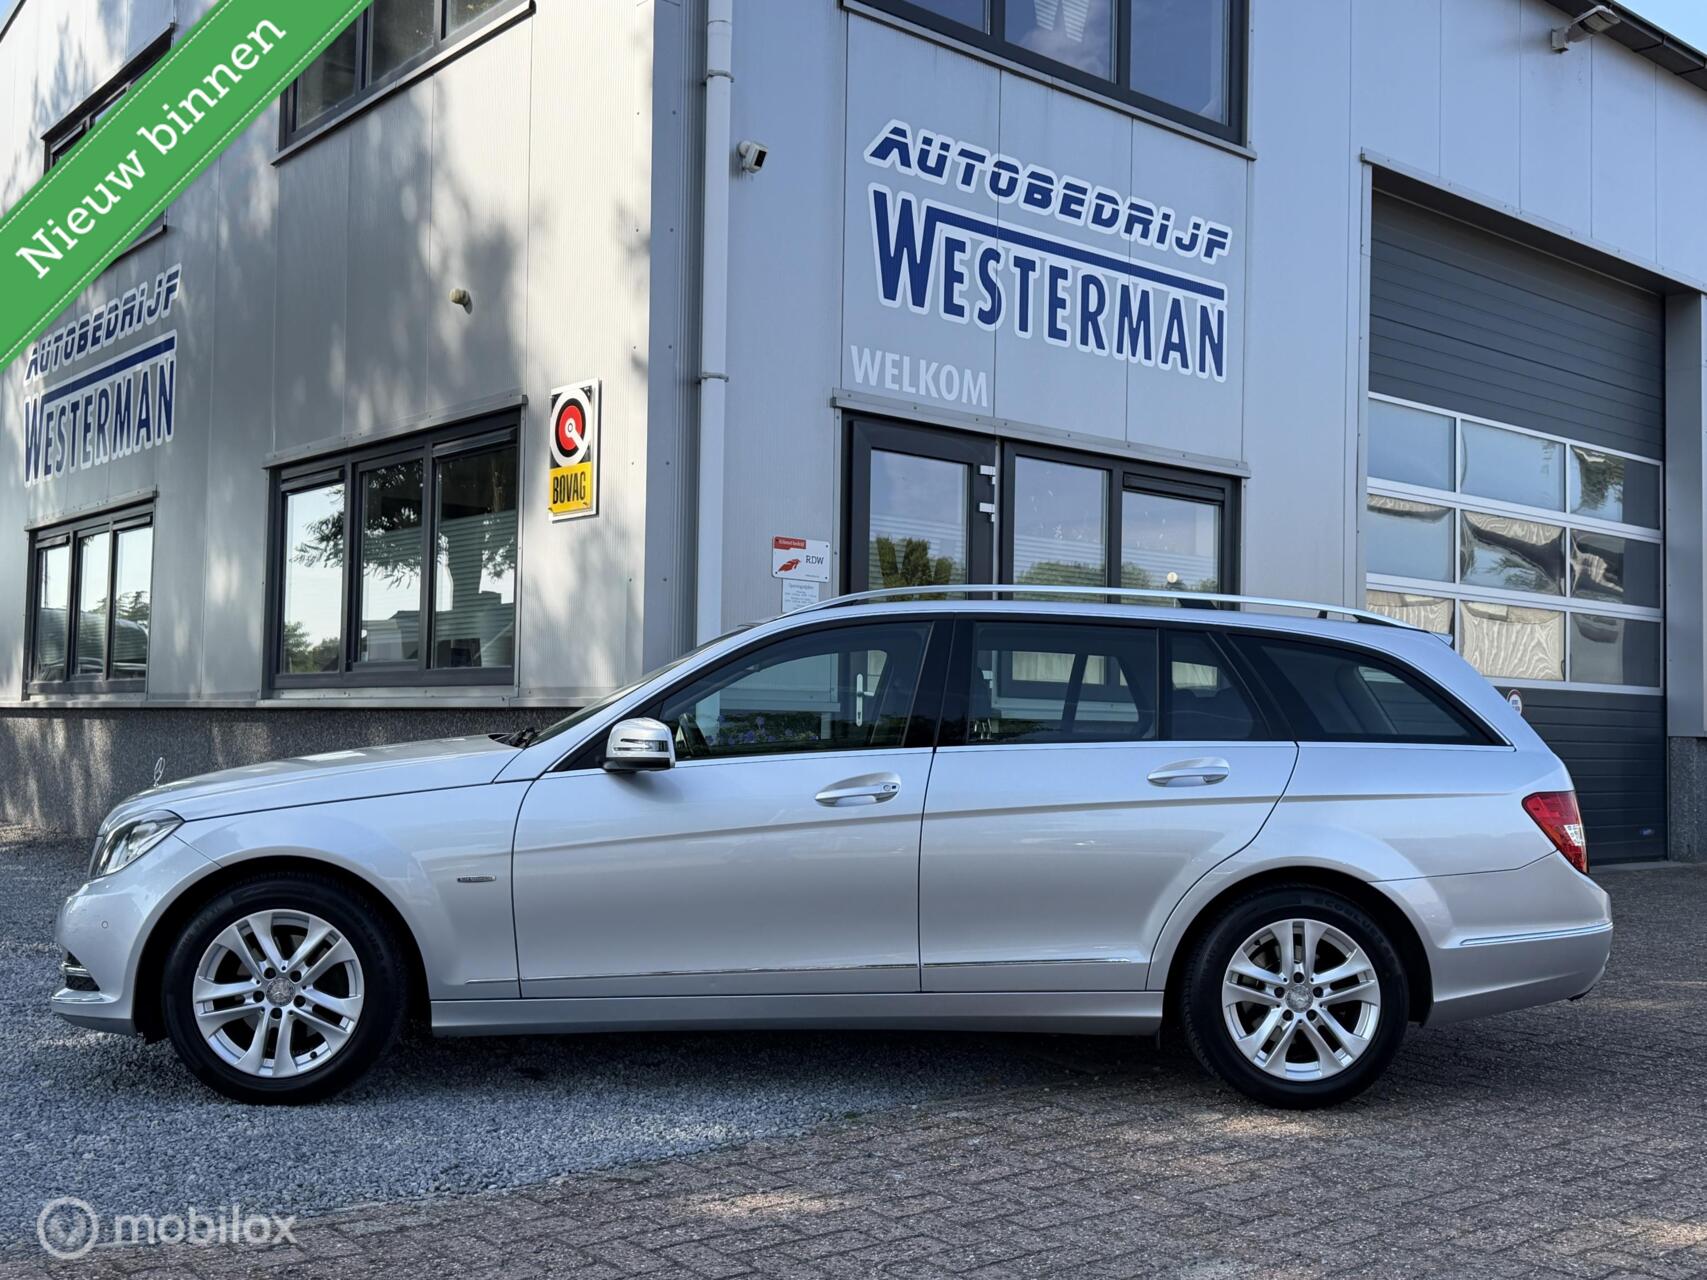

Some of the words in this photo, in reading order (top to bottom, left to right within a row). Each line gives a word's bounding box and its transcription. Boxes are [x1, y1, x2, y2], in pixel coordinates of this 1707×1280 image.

[867, 122, 1231, 262] AUTOBEDRIJF
[871, 187, 1226, 379] WESTERMAN
[24, 335, 175, 483] WESTERMAN
[850, 344, 989, 408] WELKOM
[552, 471, 586, 505] BOVAG
[805, 555, 825, 565] RDW
